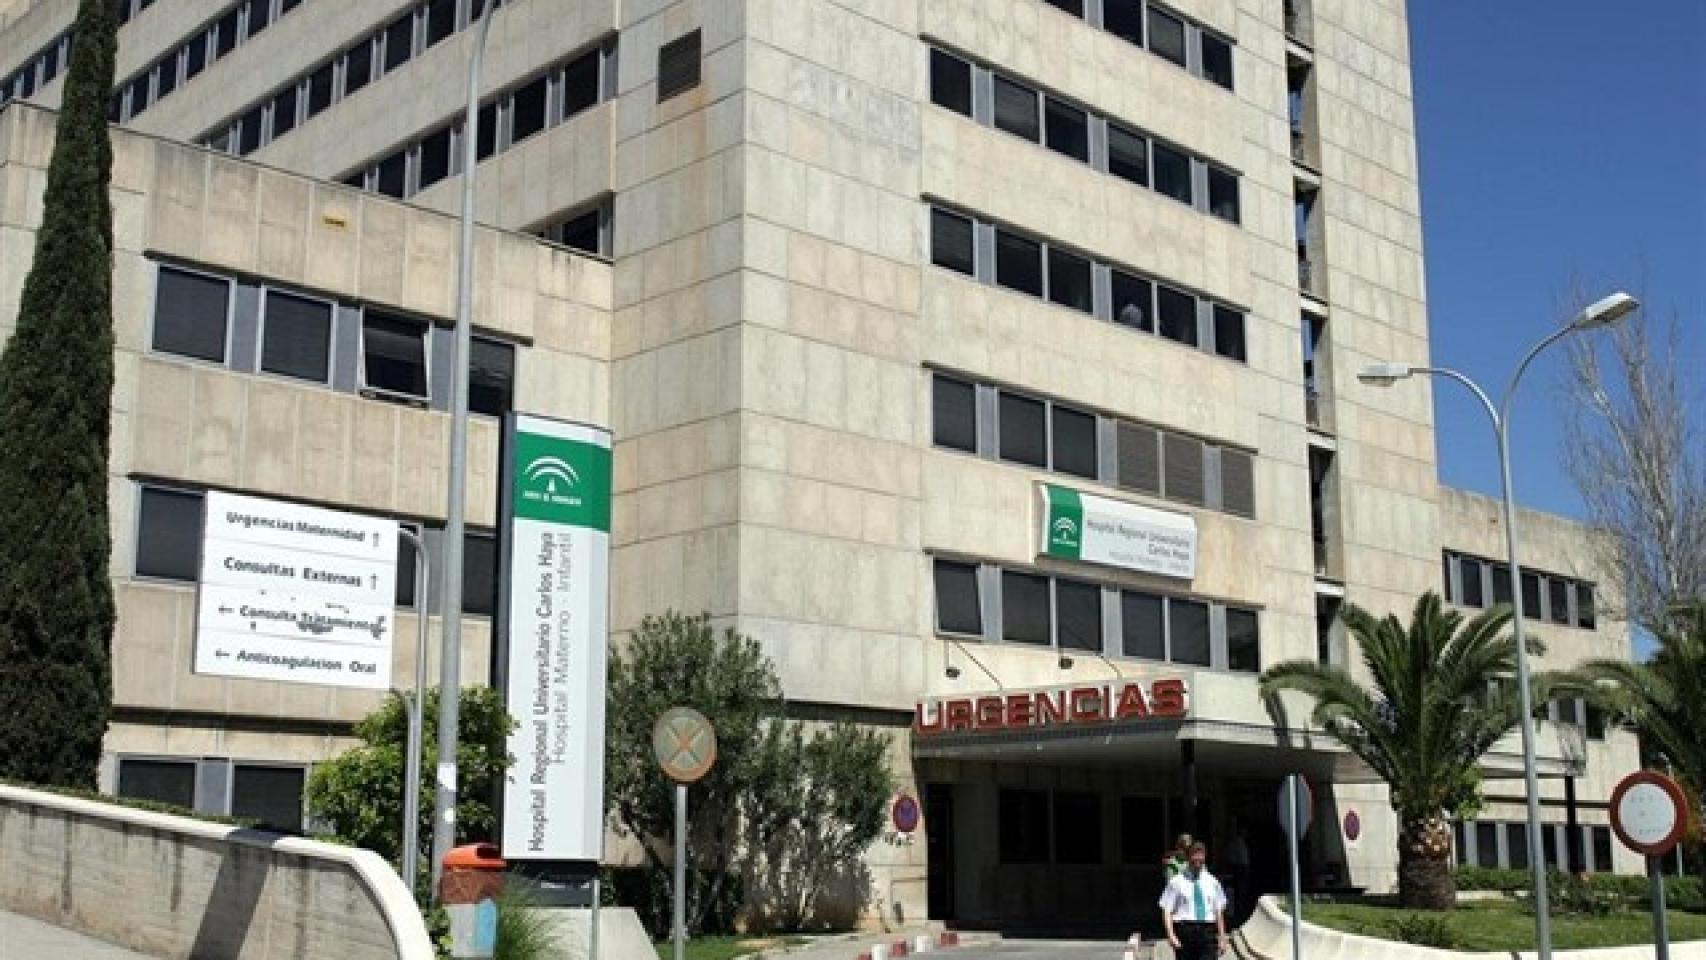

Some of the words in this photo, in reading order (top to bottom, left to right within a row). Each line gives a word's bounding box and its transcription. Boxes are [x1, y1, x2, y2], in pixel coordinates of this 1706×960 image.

[227, 511, 293, 531] Urgencias
[296, 522, 365, 541] Maternidad
[538, 532, 557, 566] Haya
[224, 557, 294, 578] Consultas
[303, 567, 363, 587] Externas
[557, 532, 572, 593] Infantil
[240, 605, 297, 622] Consulta
[536, 573, 552, 617] Carlos
[349, 661, 377, 673] Oral
[533, 623, 552, 716] Universitario
[554, 610, 570, 684] Materno
[550, 691, 569, 763] Hospital
[916, 680, 1187, 734] URGENCIAS
[530, 720, 550, 784] Regional
[528, 789, 548, 851] Hospital
